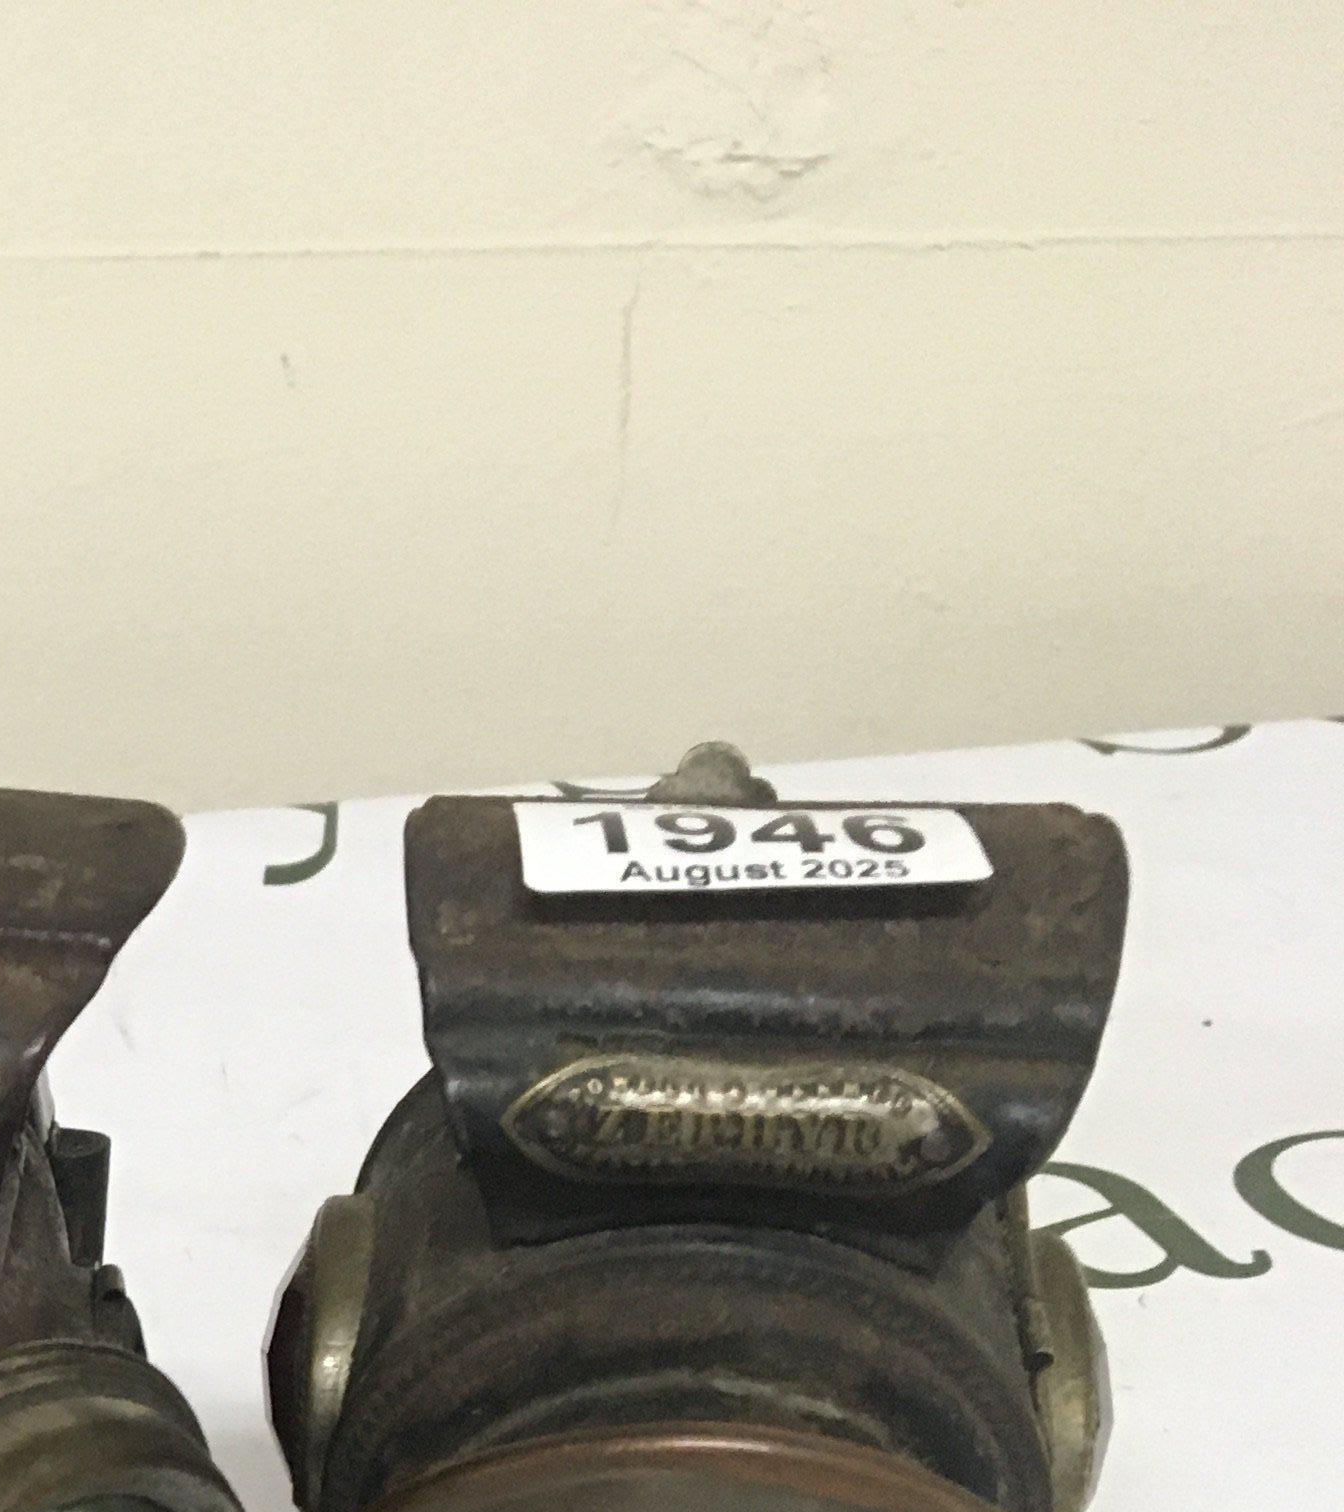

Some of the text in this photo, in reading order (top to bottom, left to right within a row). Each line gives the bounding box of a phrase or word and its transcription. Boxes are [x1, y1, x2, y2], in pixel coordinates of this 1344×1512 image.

[573, 811, 927, 854] 1946
[620, 857, 911, 888] August 2025
